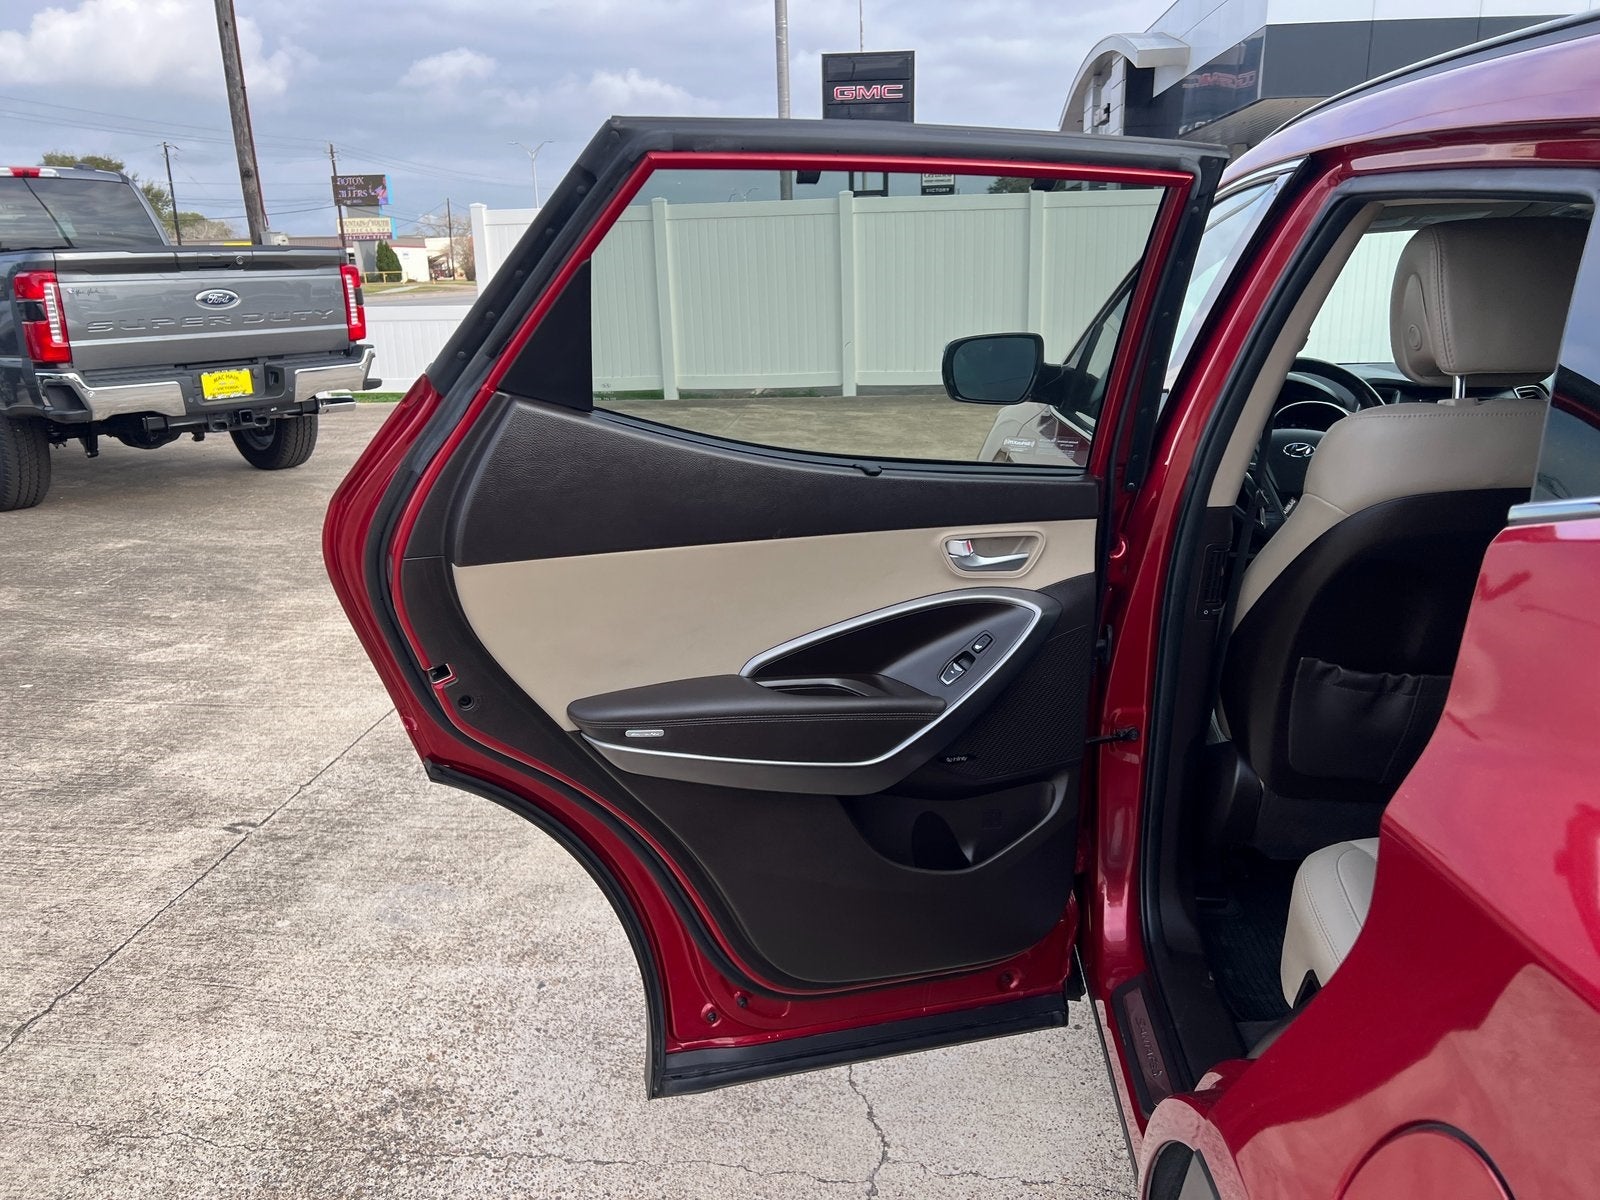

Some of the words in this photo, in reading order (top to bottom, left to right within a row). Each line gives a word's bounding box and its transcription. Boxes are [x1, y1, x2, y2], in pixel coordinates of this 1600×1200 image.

[834, 84, 904, 101] GMC
[207, 293, 230, 304] Ford
[87, 311, 233, 333] SUPER
[241, 309, 334, 324] DUTY
